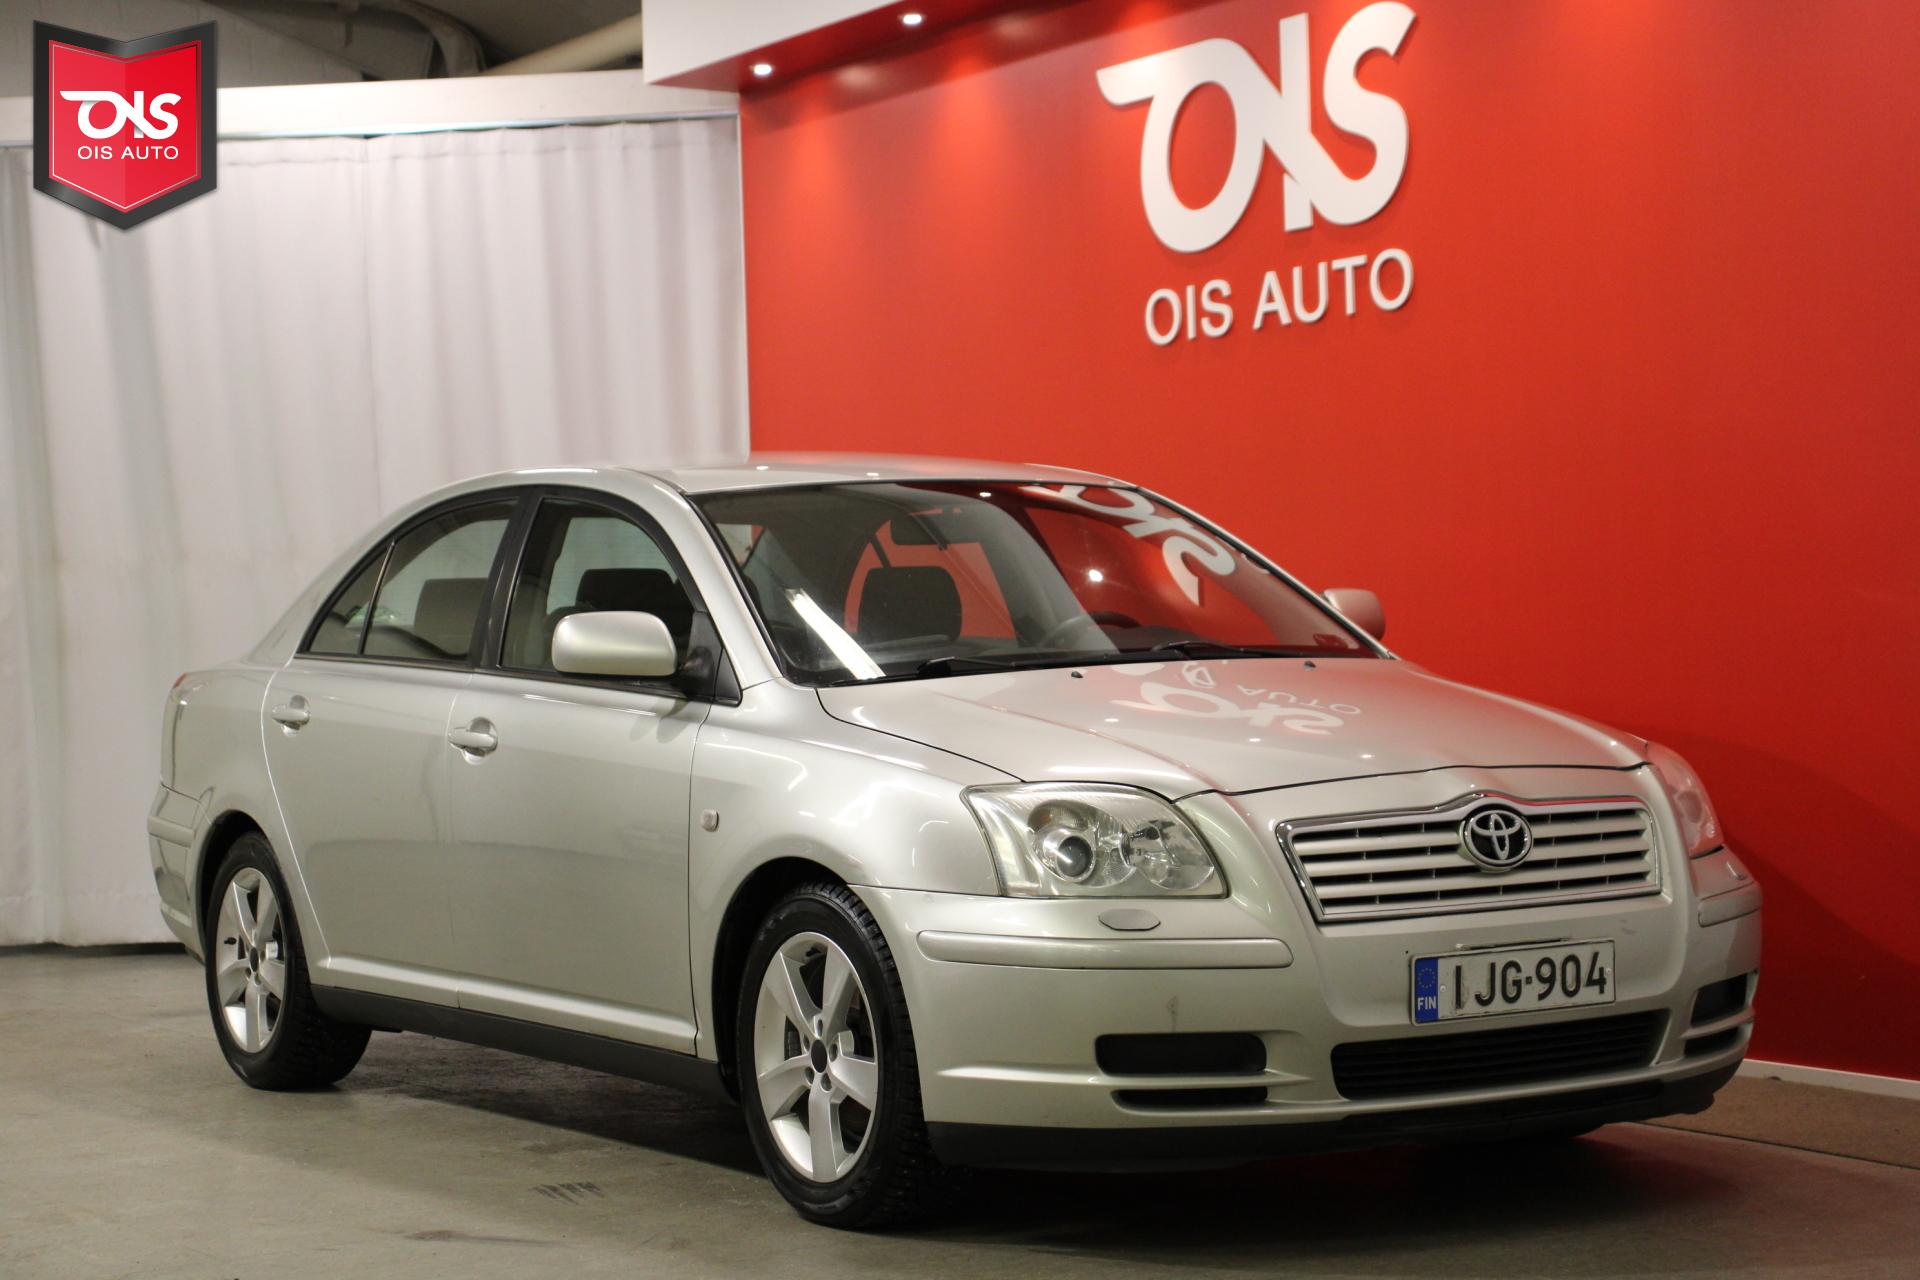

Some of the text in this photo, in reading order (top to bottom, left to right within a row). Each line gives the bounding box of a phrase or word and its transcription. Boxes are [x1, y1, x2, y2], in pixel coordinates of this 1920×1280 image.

[1145, 248, 1414, 345] OIS AUTO
[1417, 996, 1437, 1011] FIN
[1455, 952, 1607, 1010] IJG-904
